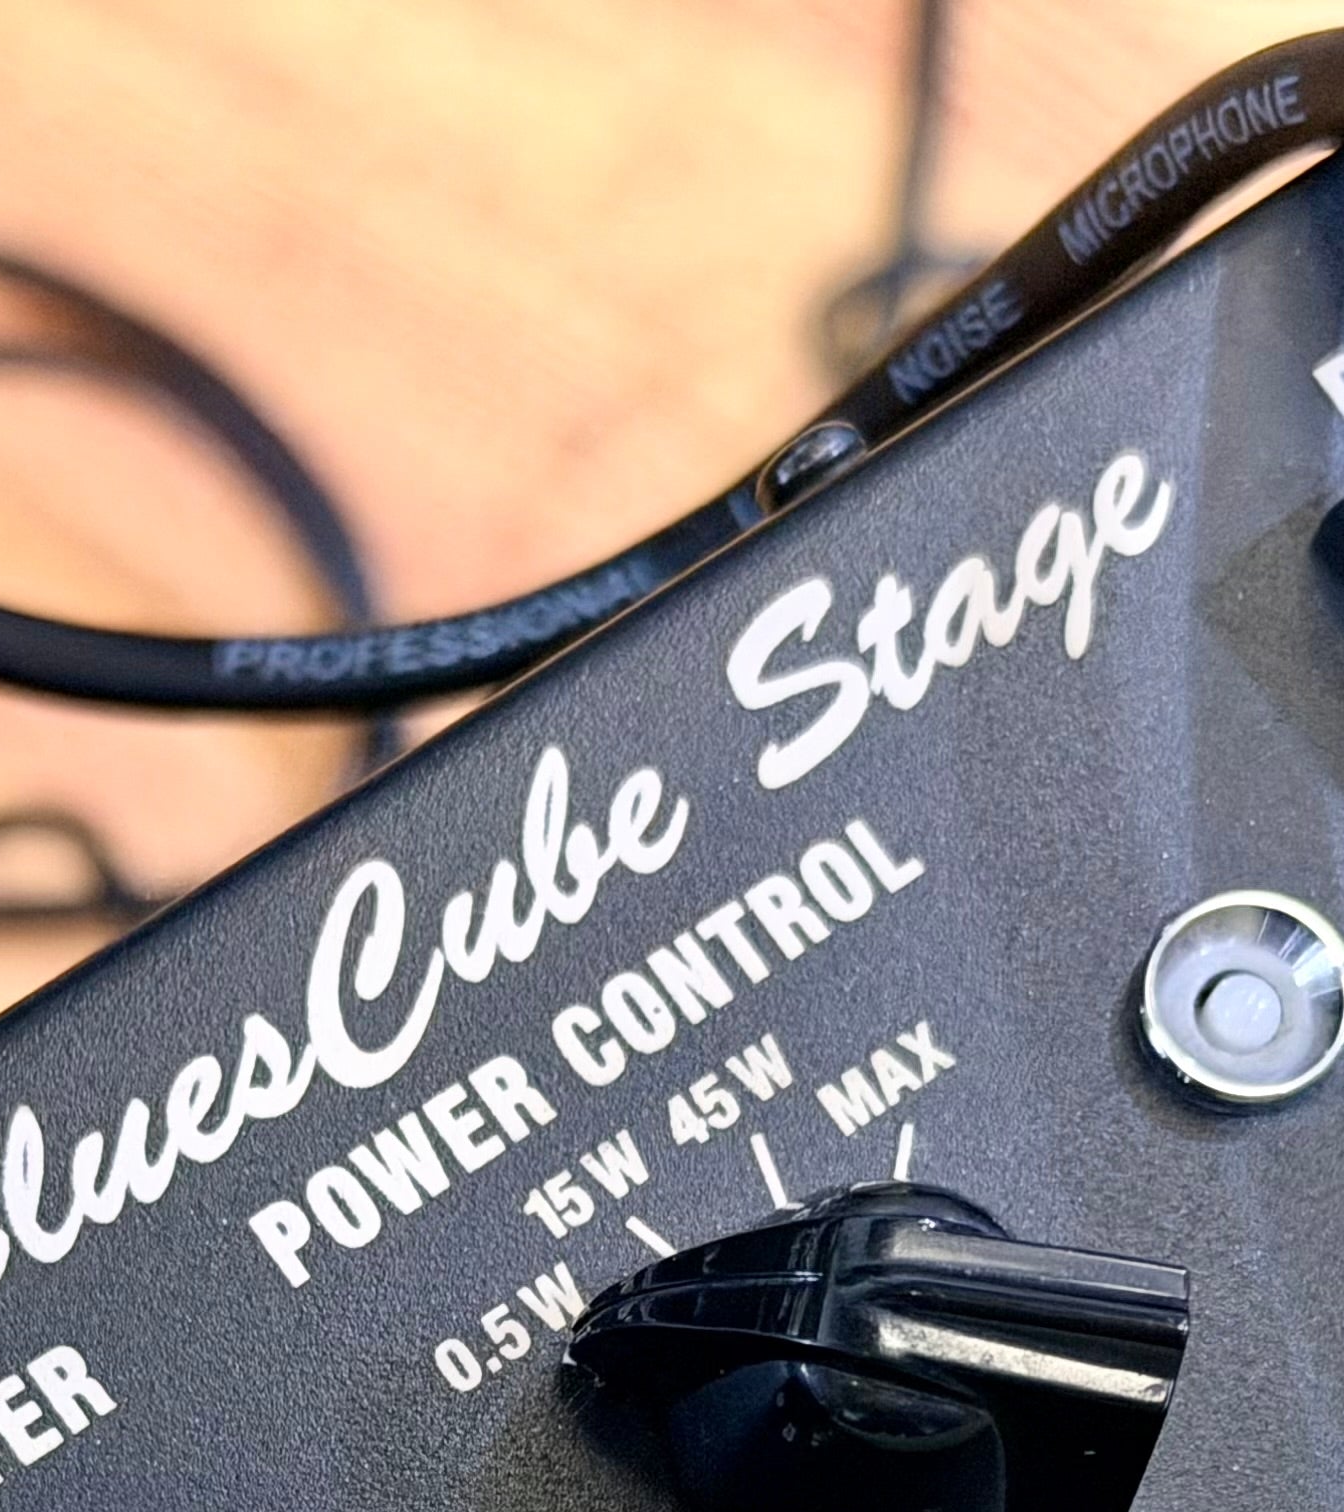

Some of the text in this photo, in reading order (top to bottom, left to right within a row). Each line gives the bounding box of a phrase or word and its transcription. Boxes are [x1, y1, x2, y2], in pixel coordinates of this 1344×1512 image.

[887, 281, 1023, 403] NOISE
[1058, 75, 1307, 265] MICROPHONE
[726, 452, 1173, 789] Stage
[249, 819, 927, 1289] POWER CONTROL
[816, 1020, 956, 1138] MAX
